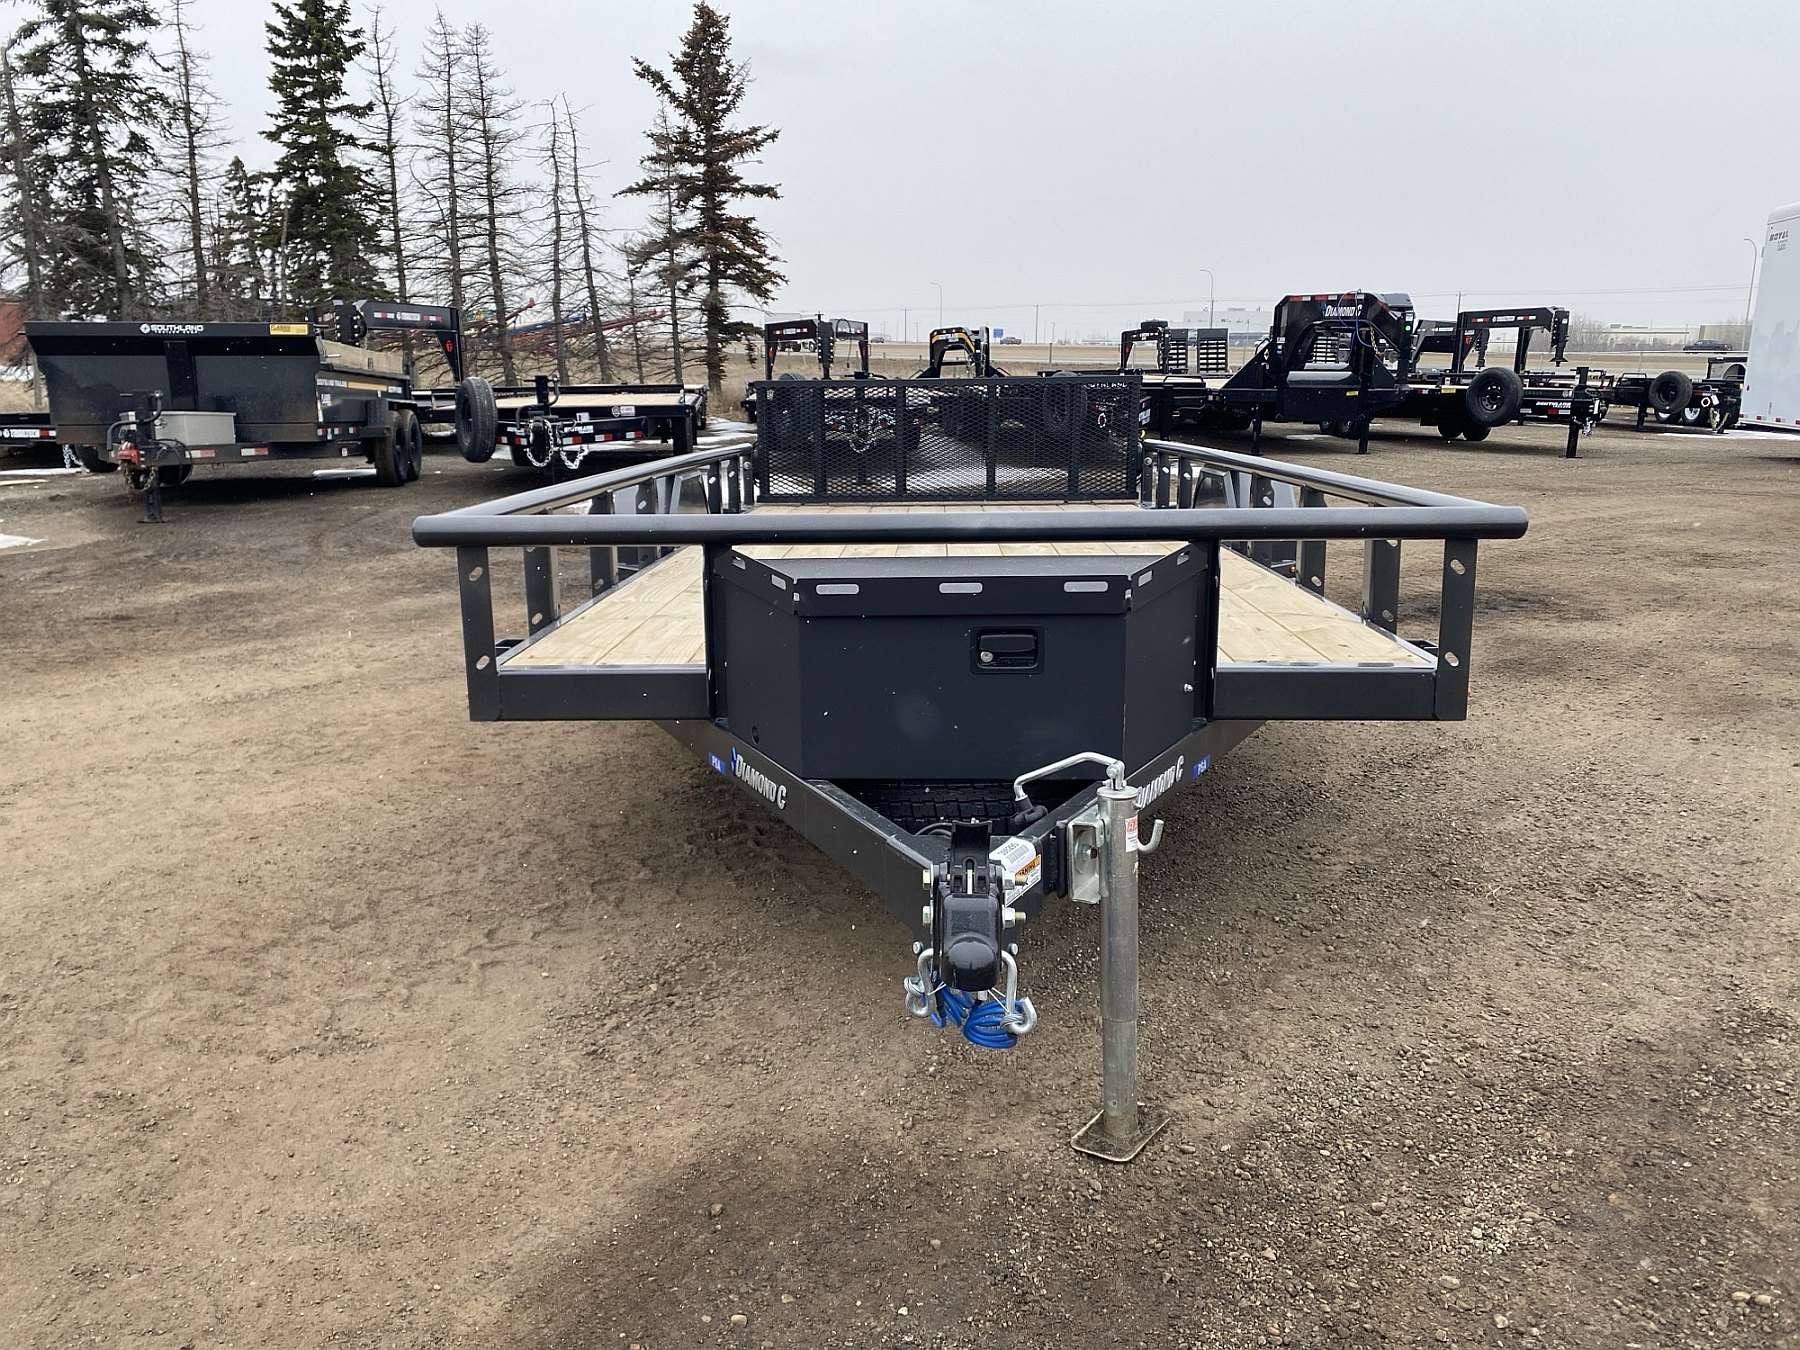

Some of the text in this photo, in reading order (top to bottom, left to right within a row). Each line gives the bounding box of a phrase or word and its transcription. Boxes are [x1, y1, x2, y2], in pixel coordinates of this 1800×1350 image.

[1325, 305, 1355, 317] DIAMOND
[150, 324, 204, 332] SOUTHLAND
[735, 753, 787, 810] DIAMOND C
